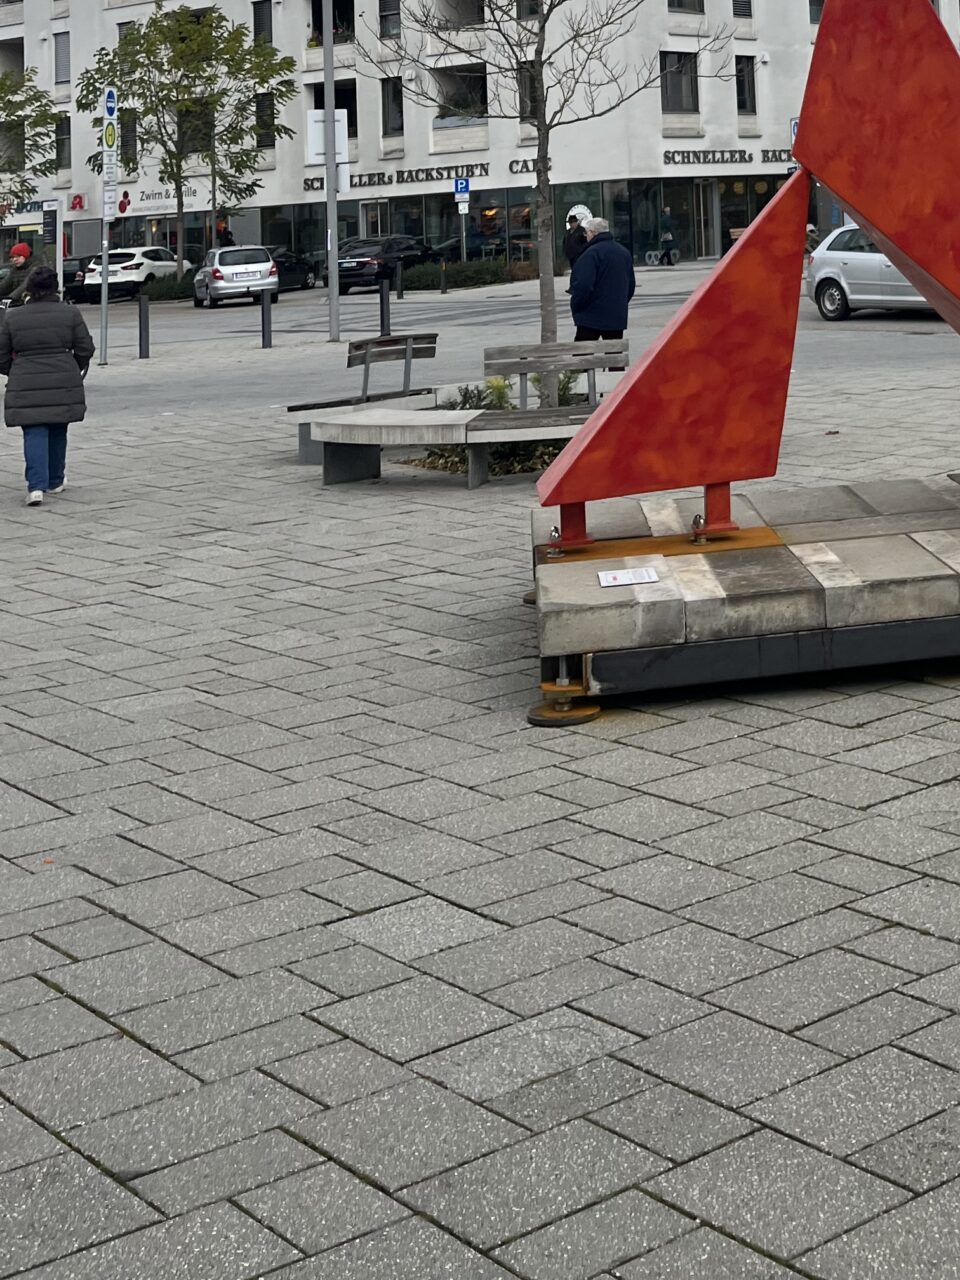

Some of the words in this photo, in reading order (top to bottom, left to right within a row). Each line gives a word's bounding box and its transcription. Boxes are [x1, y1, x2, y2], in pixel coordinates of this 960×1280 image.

[663, 149, 753, 165] SCHNELLERs
[457, 180, 466, 191] P
[139, 190, 163, 201] Zwirn
[164, 188, 171, 199] &
